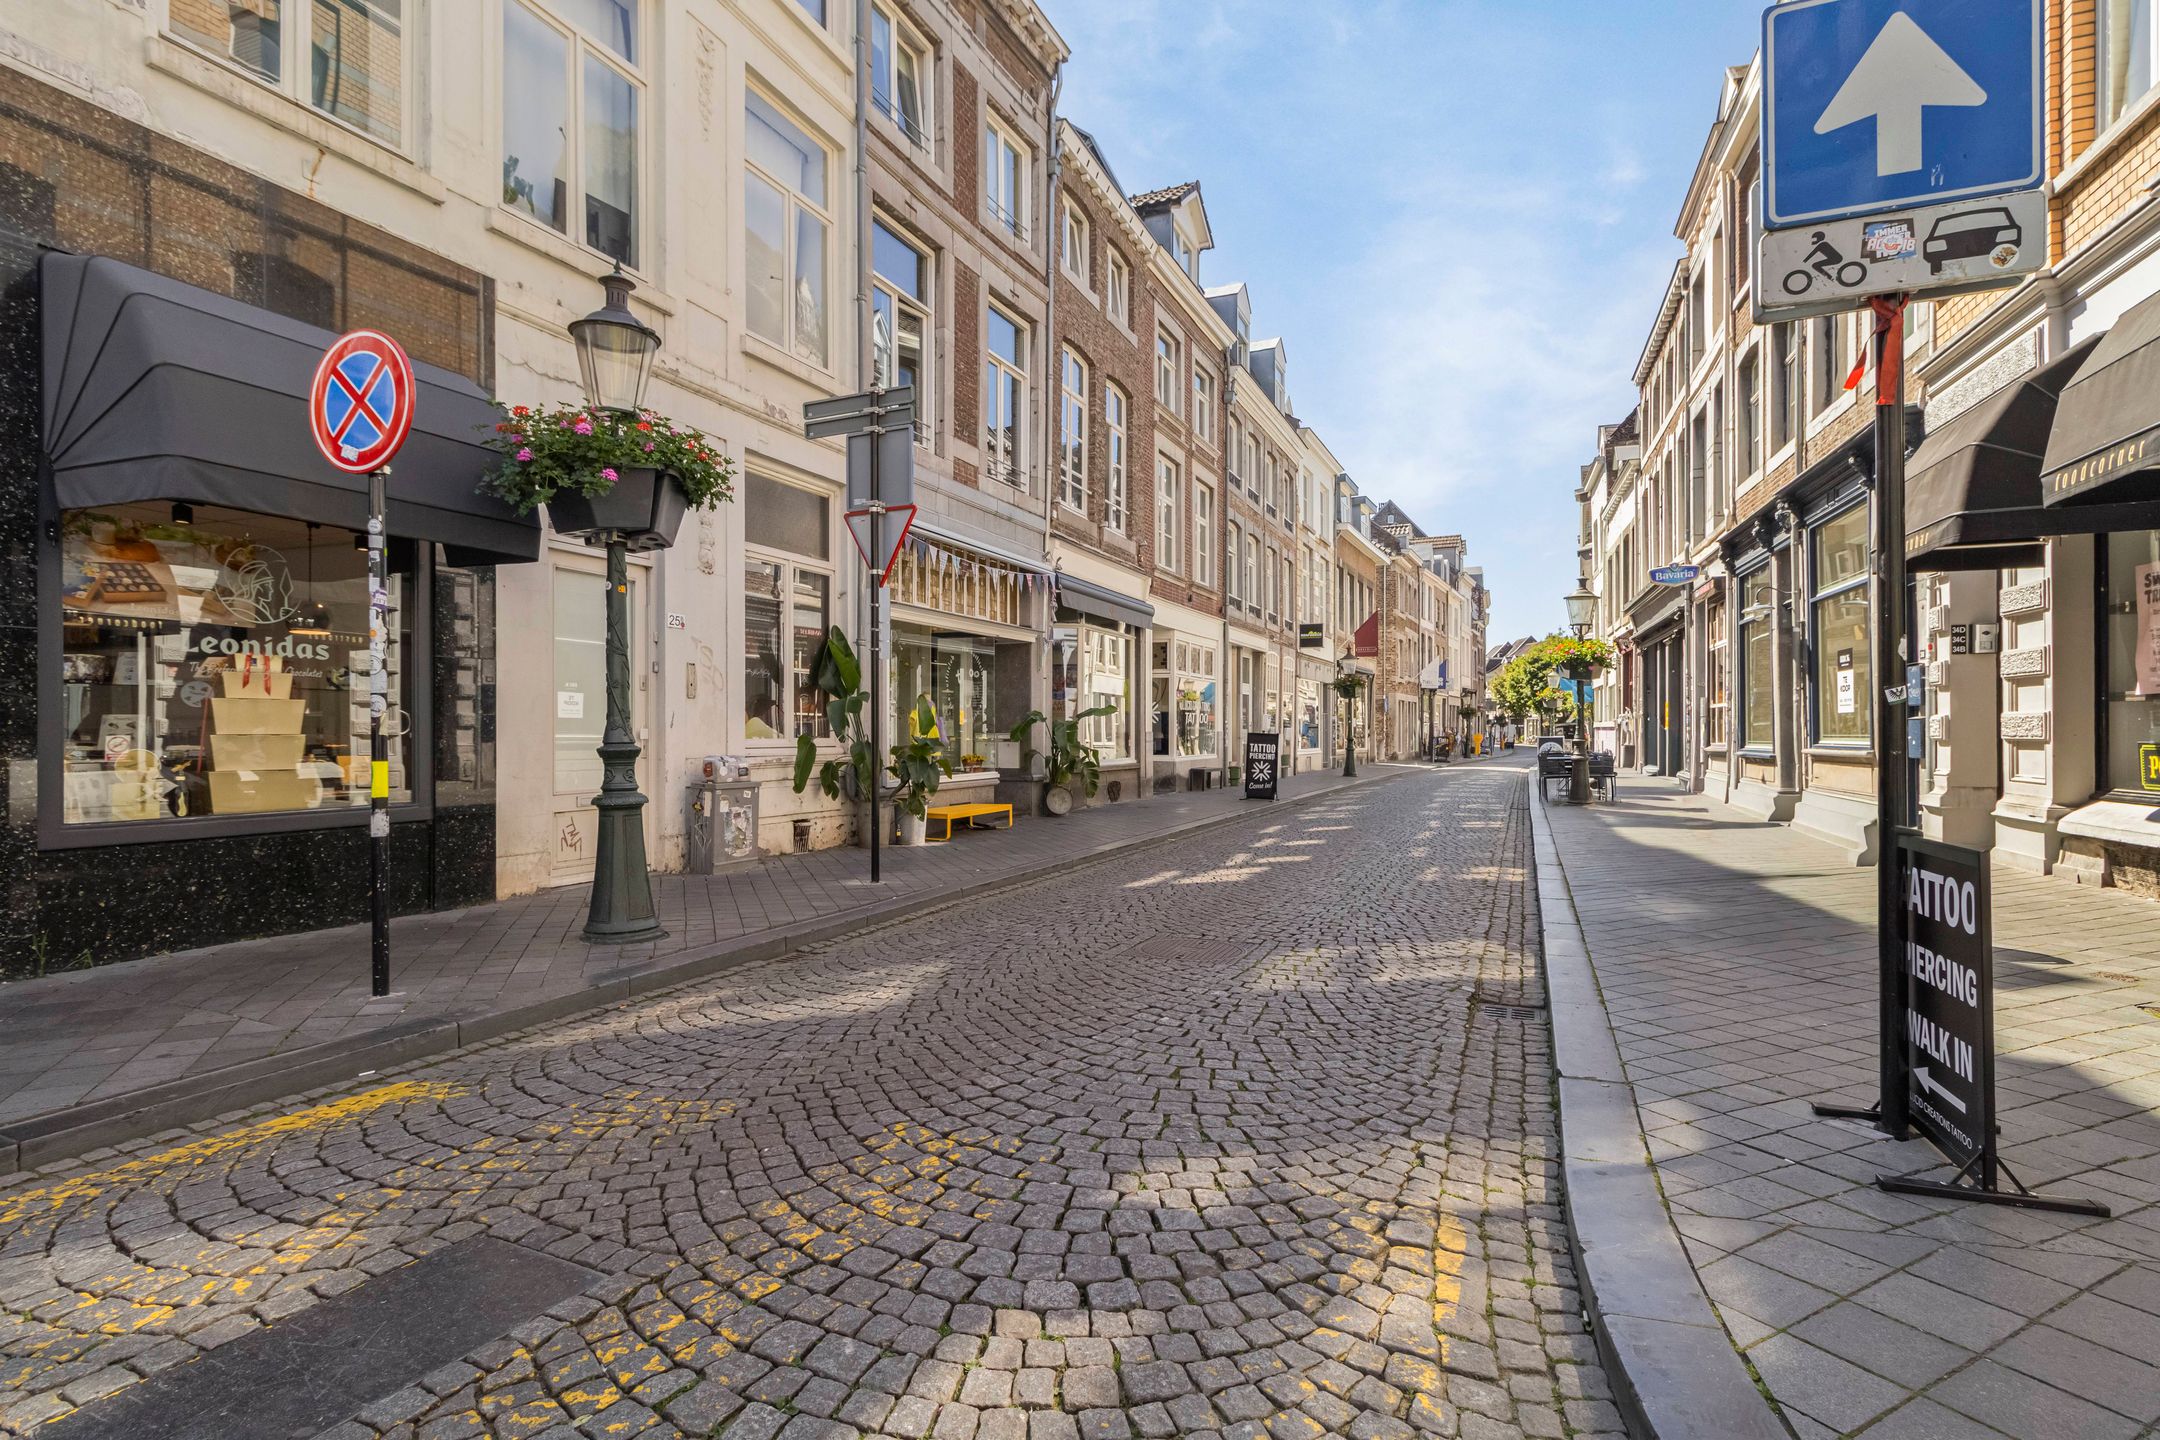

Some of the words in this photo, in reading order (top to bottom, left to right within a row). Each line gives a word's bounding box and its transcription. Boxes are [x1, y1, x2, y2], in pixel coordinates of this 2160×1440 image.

[1655, 570, 1694, 581] Bavaria
[186, 634, 330, 661] Leonidas
[1185, 712, 1208, 725] TATOO
[1249, 743, 1276, 753] TATTOO
[2149, 755, 2160, 779] P
[1908, 867, 1975, 935] ATTOO
[1907, 1007, 1951, 1068] WALK
[1954, 1036, 1973, 1083] IN
[1950, 1123, 1973, 1150] TATTOO
